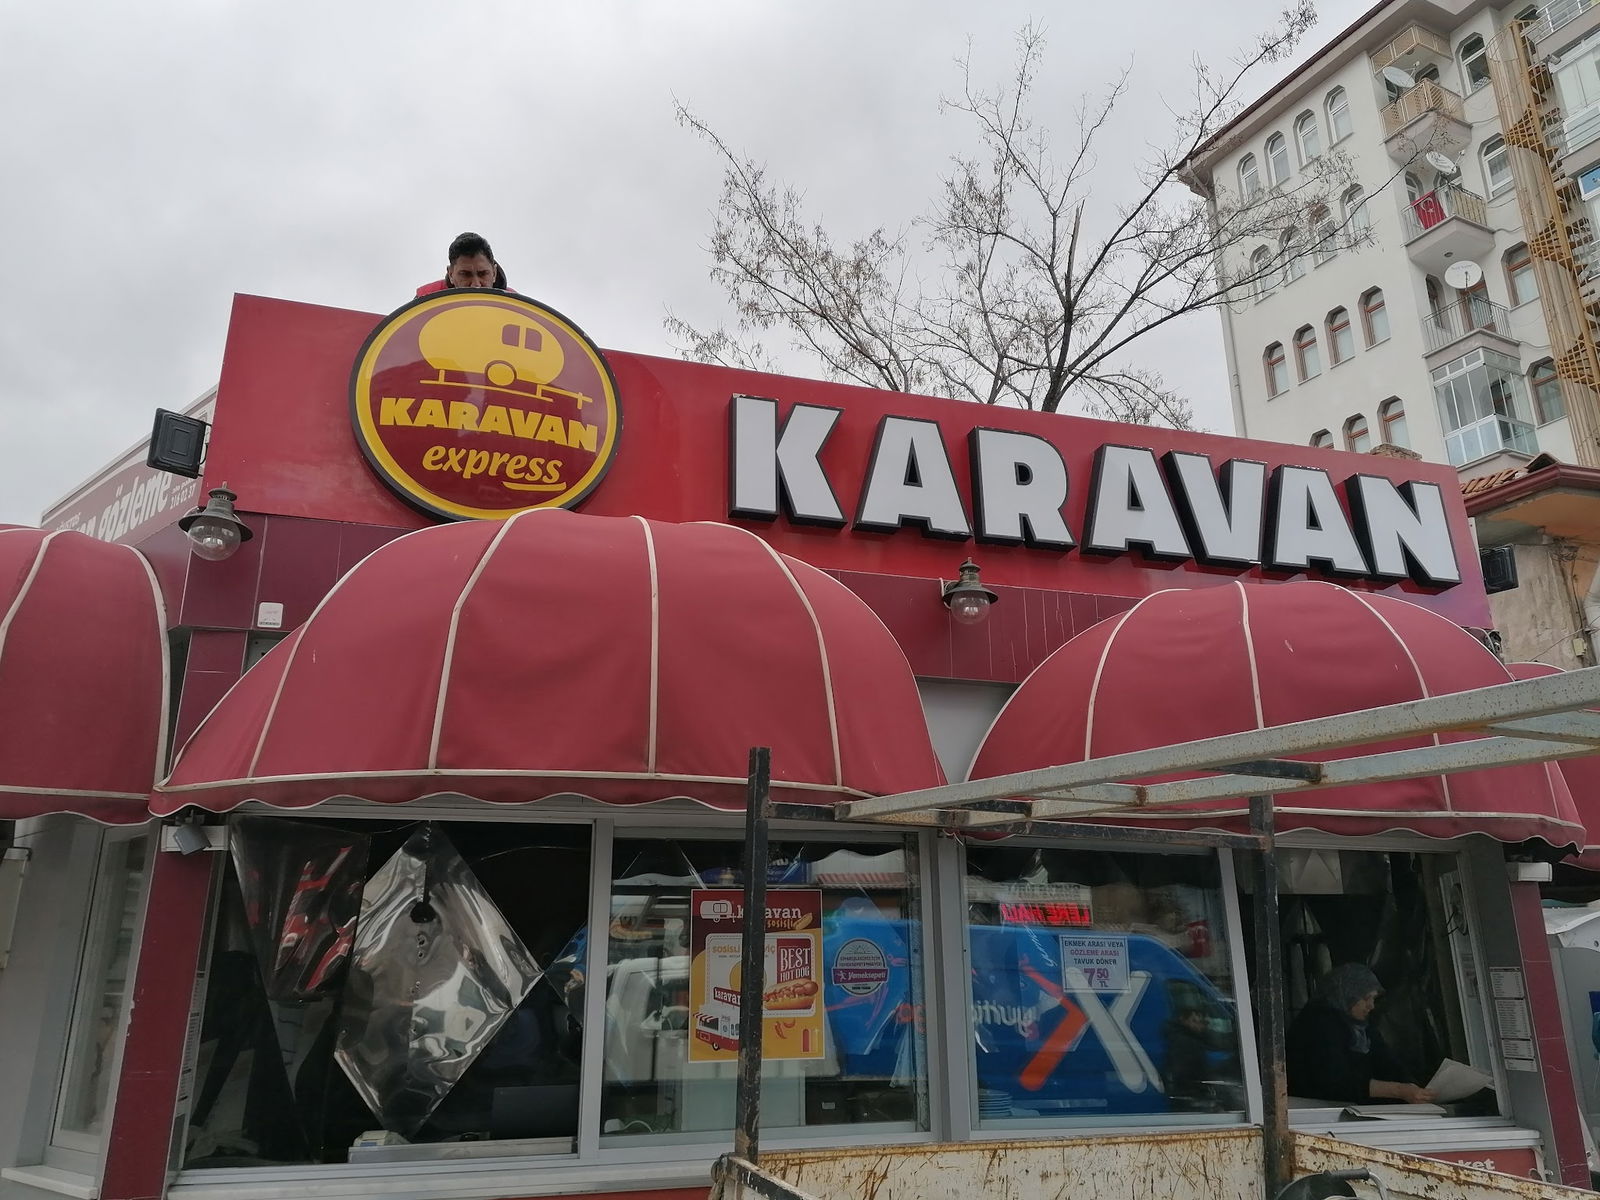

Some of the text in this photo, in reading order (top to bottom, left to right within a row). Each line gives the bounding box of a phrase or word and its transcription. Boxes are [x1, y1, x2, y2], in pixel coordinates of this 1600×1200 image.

[379, 397, 598, 453] KARAVAN
[422, 445, 563, 484] express
[729, 393, 1462, 584] KARAVAN
[737, 903, 801, 920] kavan
[780, 947, 811, 972] BEST
[1095, 957, 1117, 966] DÖNER
[781, 965, 810, 982] HOT DOG
[1083, 967, 1109, 988] 7 50
